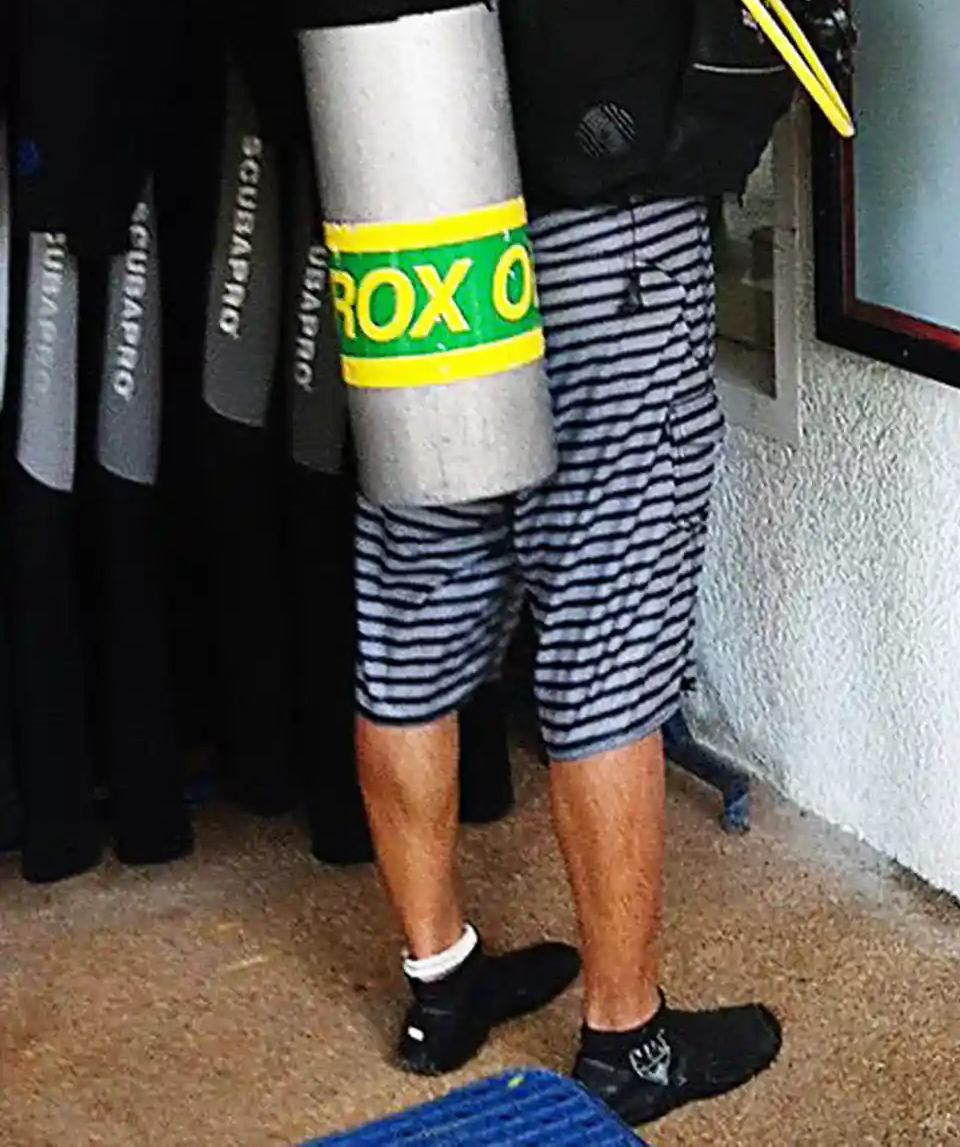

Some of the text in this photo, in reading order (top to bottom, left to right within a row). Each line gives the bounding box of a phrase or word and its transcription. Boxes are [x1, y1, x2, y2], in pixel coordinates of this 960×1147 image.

[112, 202, 151, 401] SCUBAPRO
[217, 135, 263, 341] SCUBAPRO
[294, 244, 329, 393] UBAPRO
[330, 266, 474, 342] ROX
